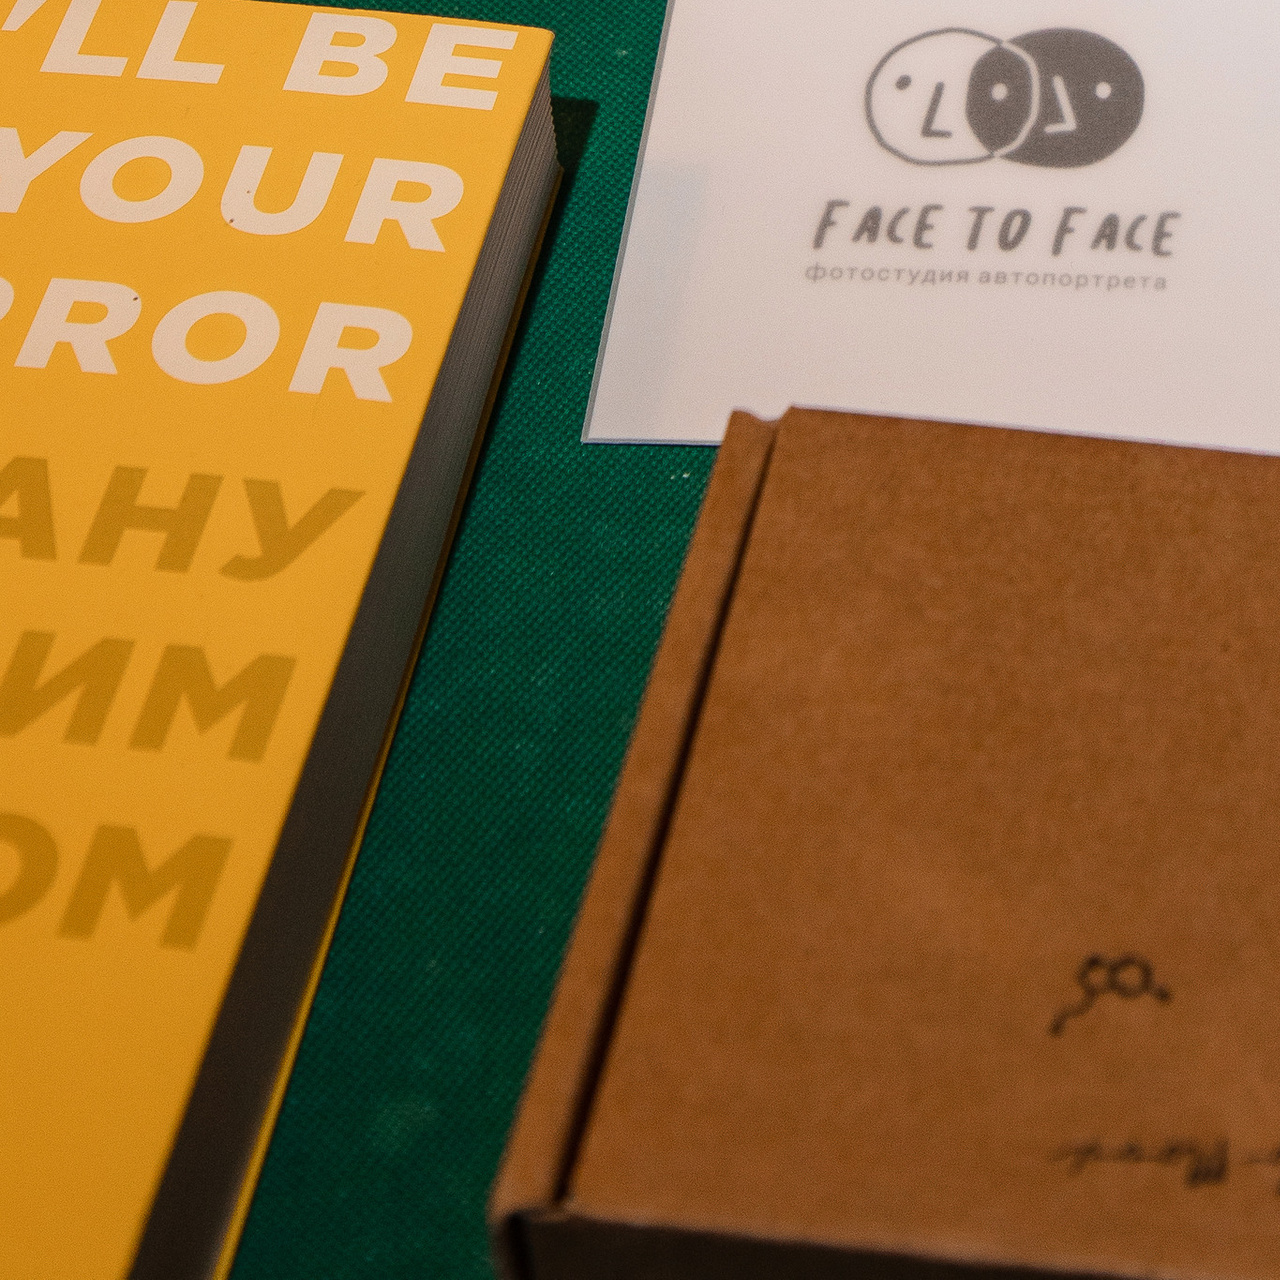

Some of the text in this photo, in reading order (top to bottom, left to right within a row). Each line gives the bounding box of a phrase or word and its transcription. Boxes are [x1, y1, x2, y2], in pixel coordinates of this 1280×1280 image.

[282, 12, 518, 111] BE
[0, 126, 464, 252] YOUR
[812, 199, 1181, 257] FACE TO FACE
[805, 263, 1168, 291] фотостудия автопортрета
[0, 276, 413, 403] ROR
